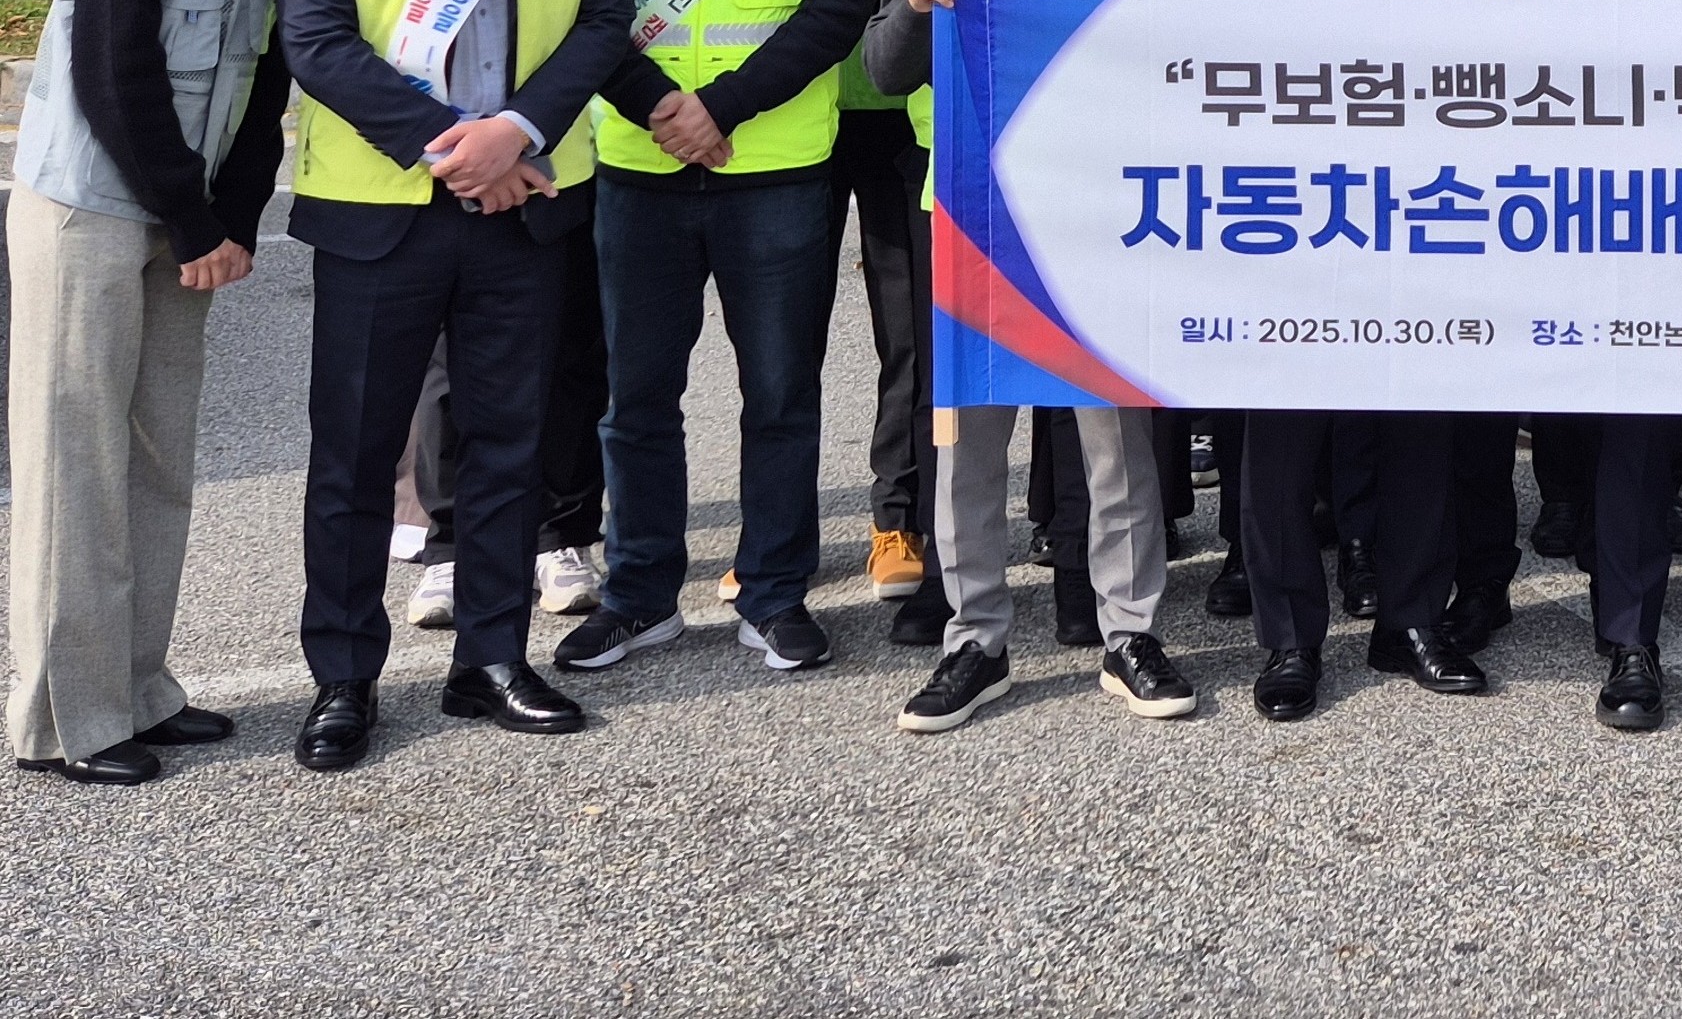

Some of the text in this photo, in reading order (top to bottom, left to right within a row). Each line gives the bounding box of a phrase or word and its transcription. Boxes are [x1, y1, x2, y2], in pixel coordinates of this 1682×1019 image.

[1180, 317, 1233, 343] 일시
[1258, 317, 1496, 346] 2025.10.30.(목)
[1531, 319, 1584, 347] 장소
